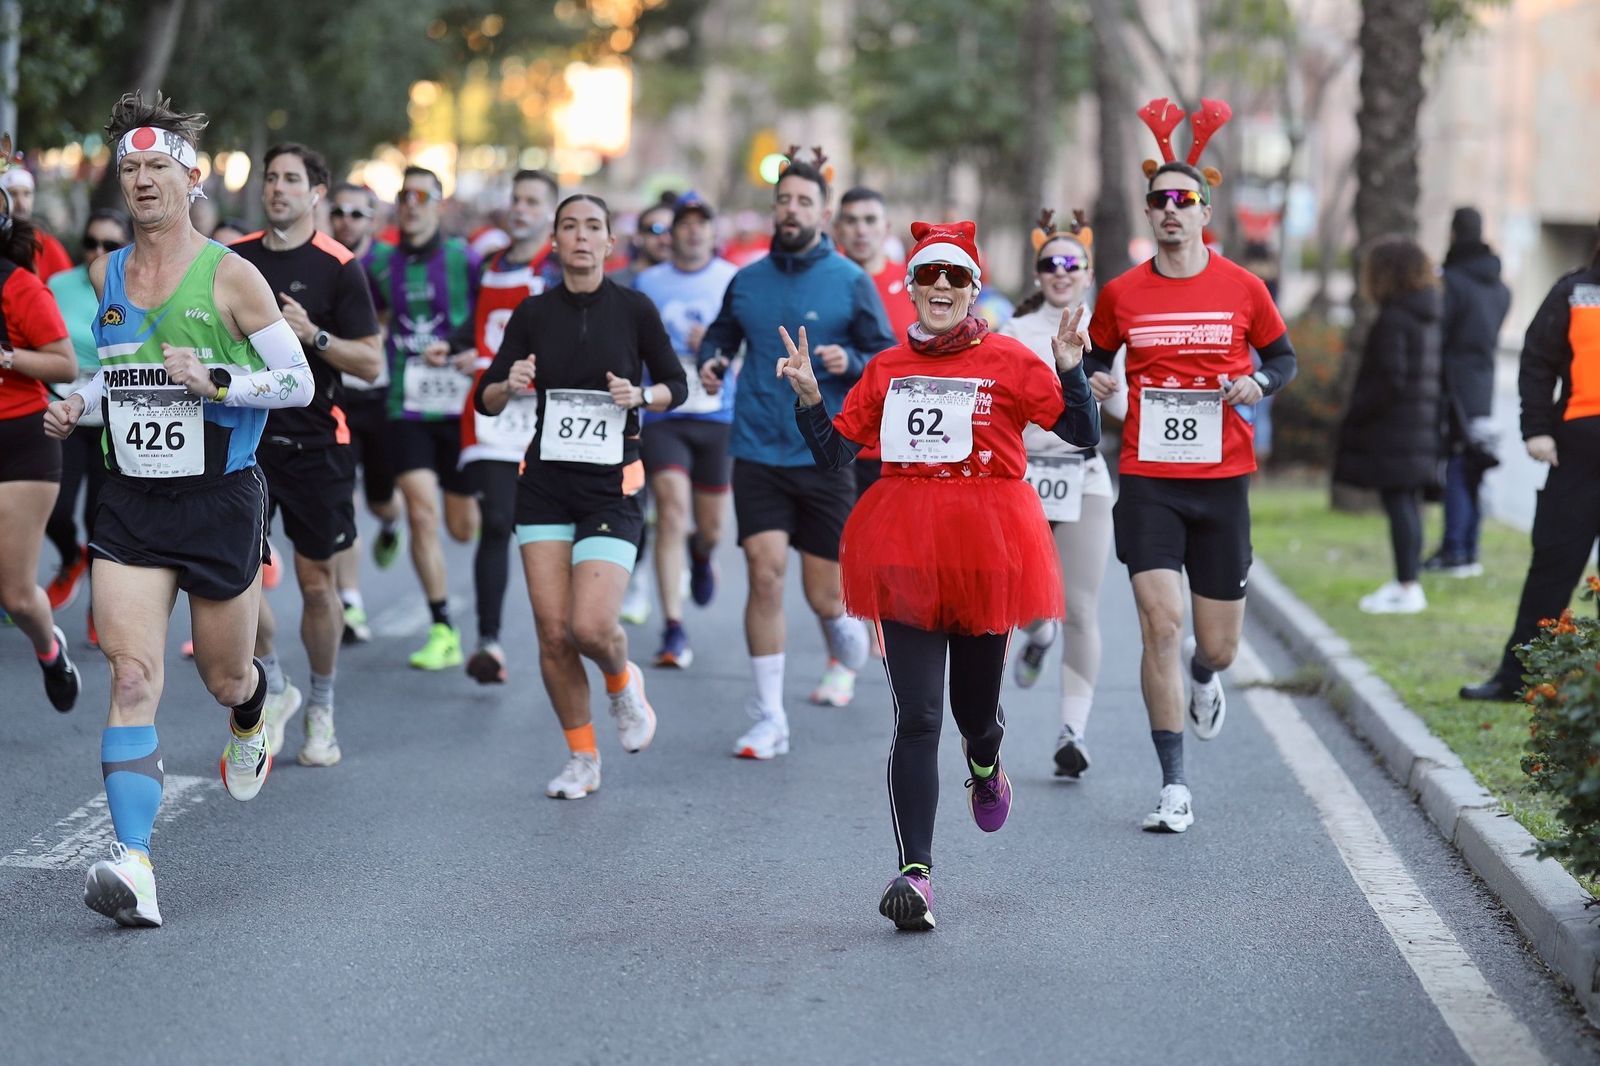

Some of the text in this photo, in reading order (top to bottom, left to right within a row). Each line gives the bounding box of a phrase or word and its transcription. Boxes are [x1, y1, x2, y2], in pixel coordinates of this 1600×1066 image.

[976, 392, 993, 400] ERA
[558, 417, 608, 442] 874
[907, 407, 944, 436] 62
[1164, 417, 1198, 441] 88
[126, 421, 186, 451] 426
[1027, 478, 1068, 500] 00
